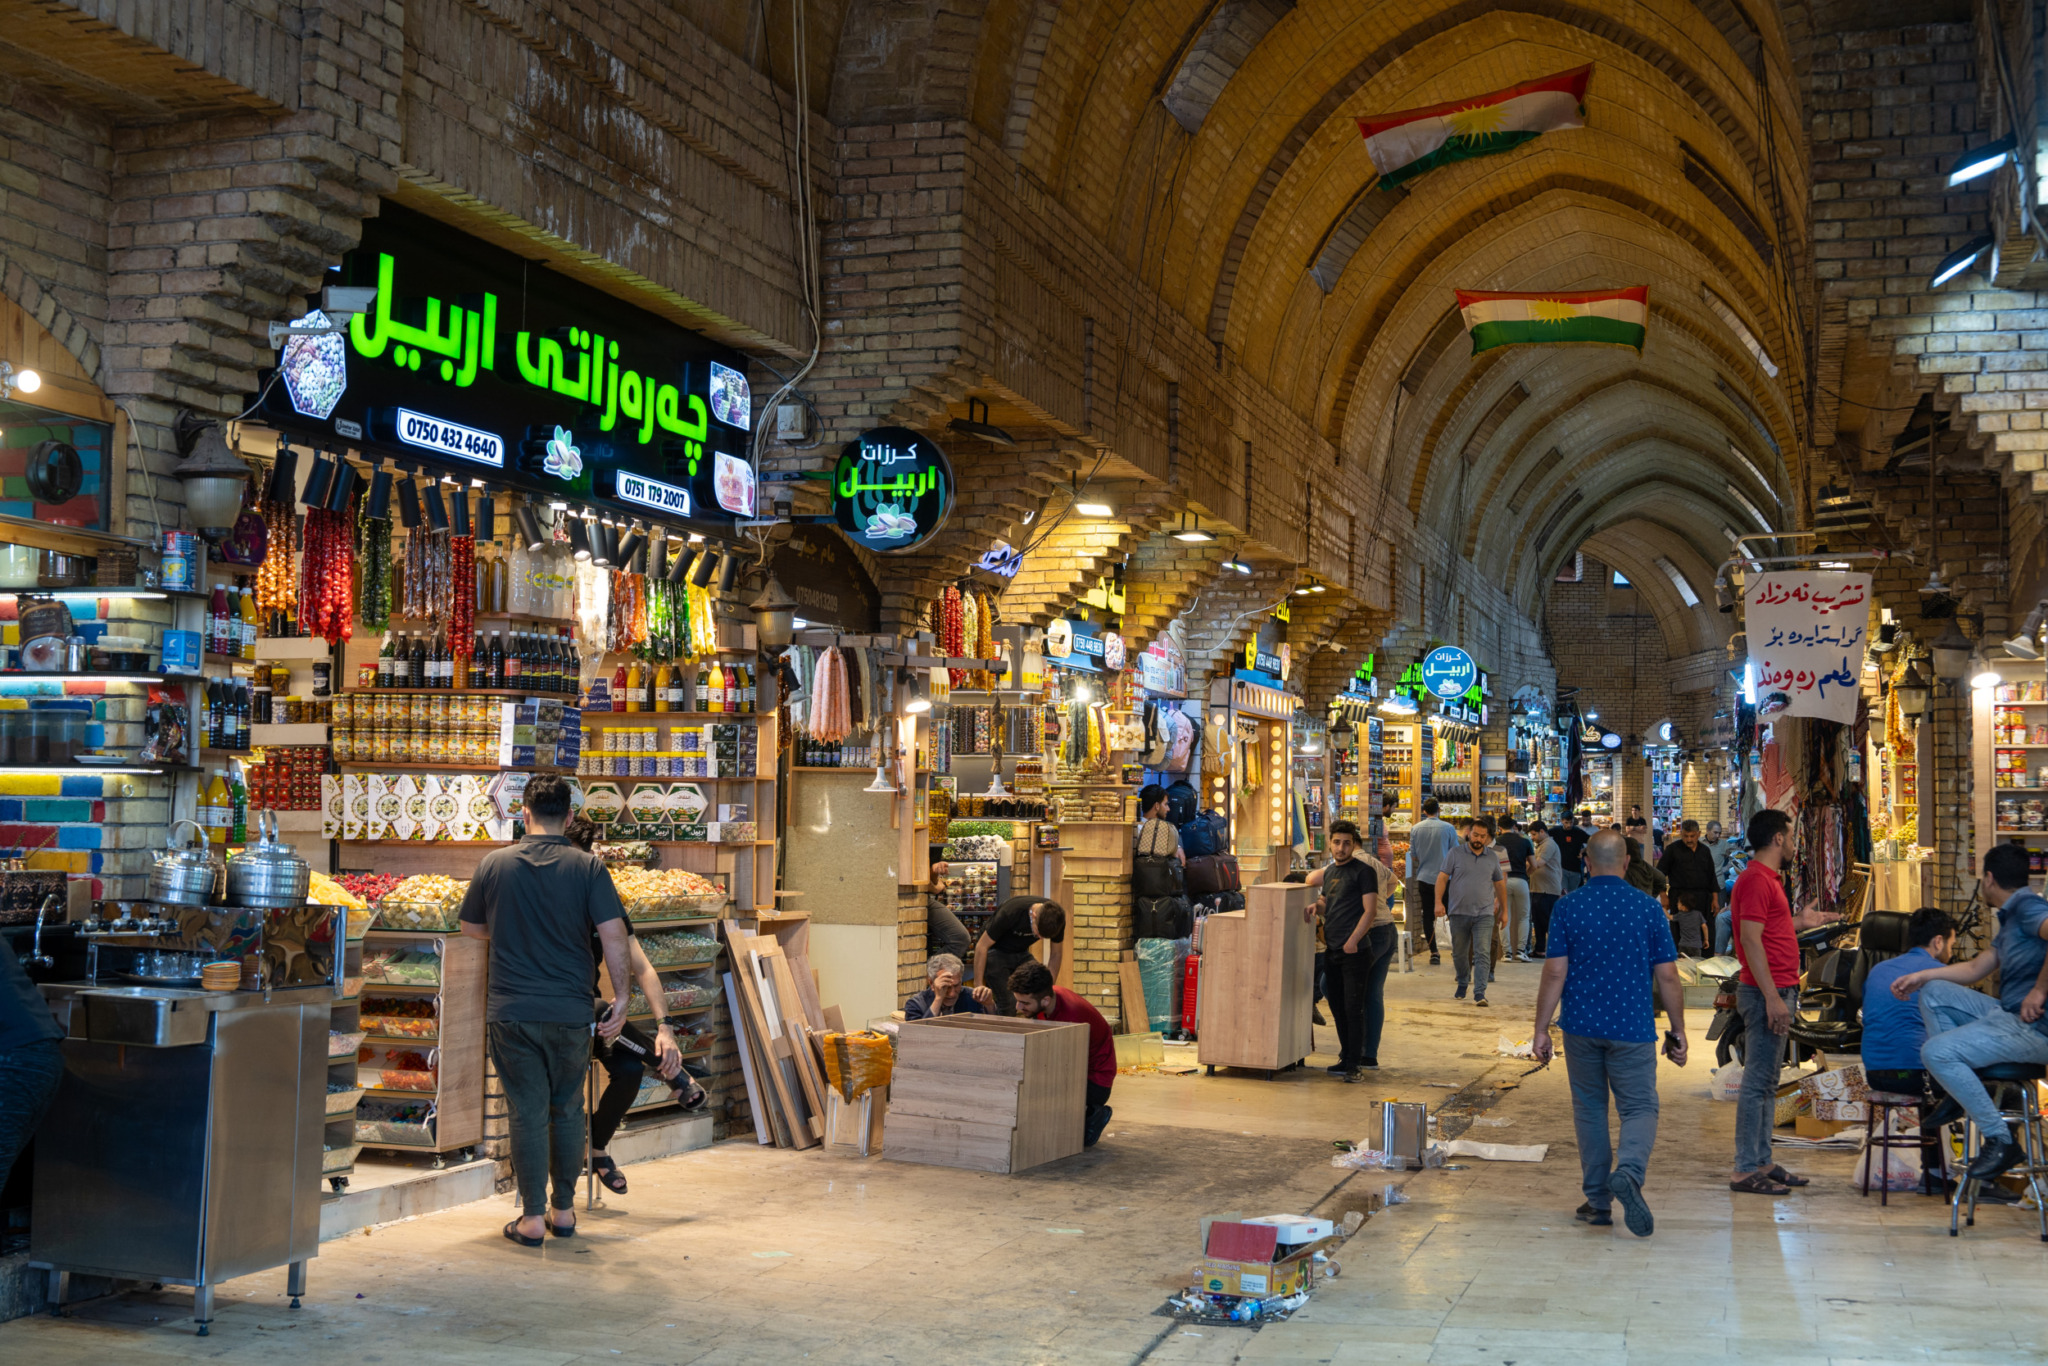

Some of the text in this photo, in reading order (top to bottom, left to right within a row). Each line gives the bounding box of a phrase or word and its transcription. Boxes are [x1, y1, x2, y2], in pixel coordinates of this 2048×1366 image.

[407, 417, 497, 458] 0750 432 4640
[862, 442, 918, 465] كرزات
[625, 478, 685, 509] 0751 179 2007
[840, 465, 936, 498] اربيل
[1425, 662, 1470, 677] اربيل
[1435, 652, 1461, 663] كرزات
[1818, 656, 1856, 699] مطعم
